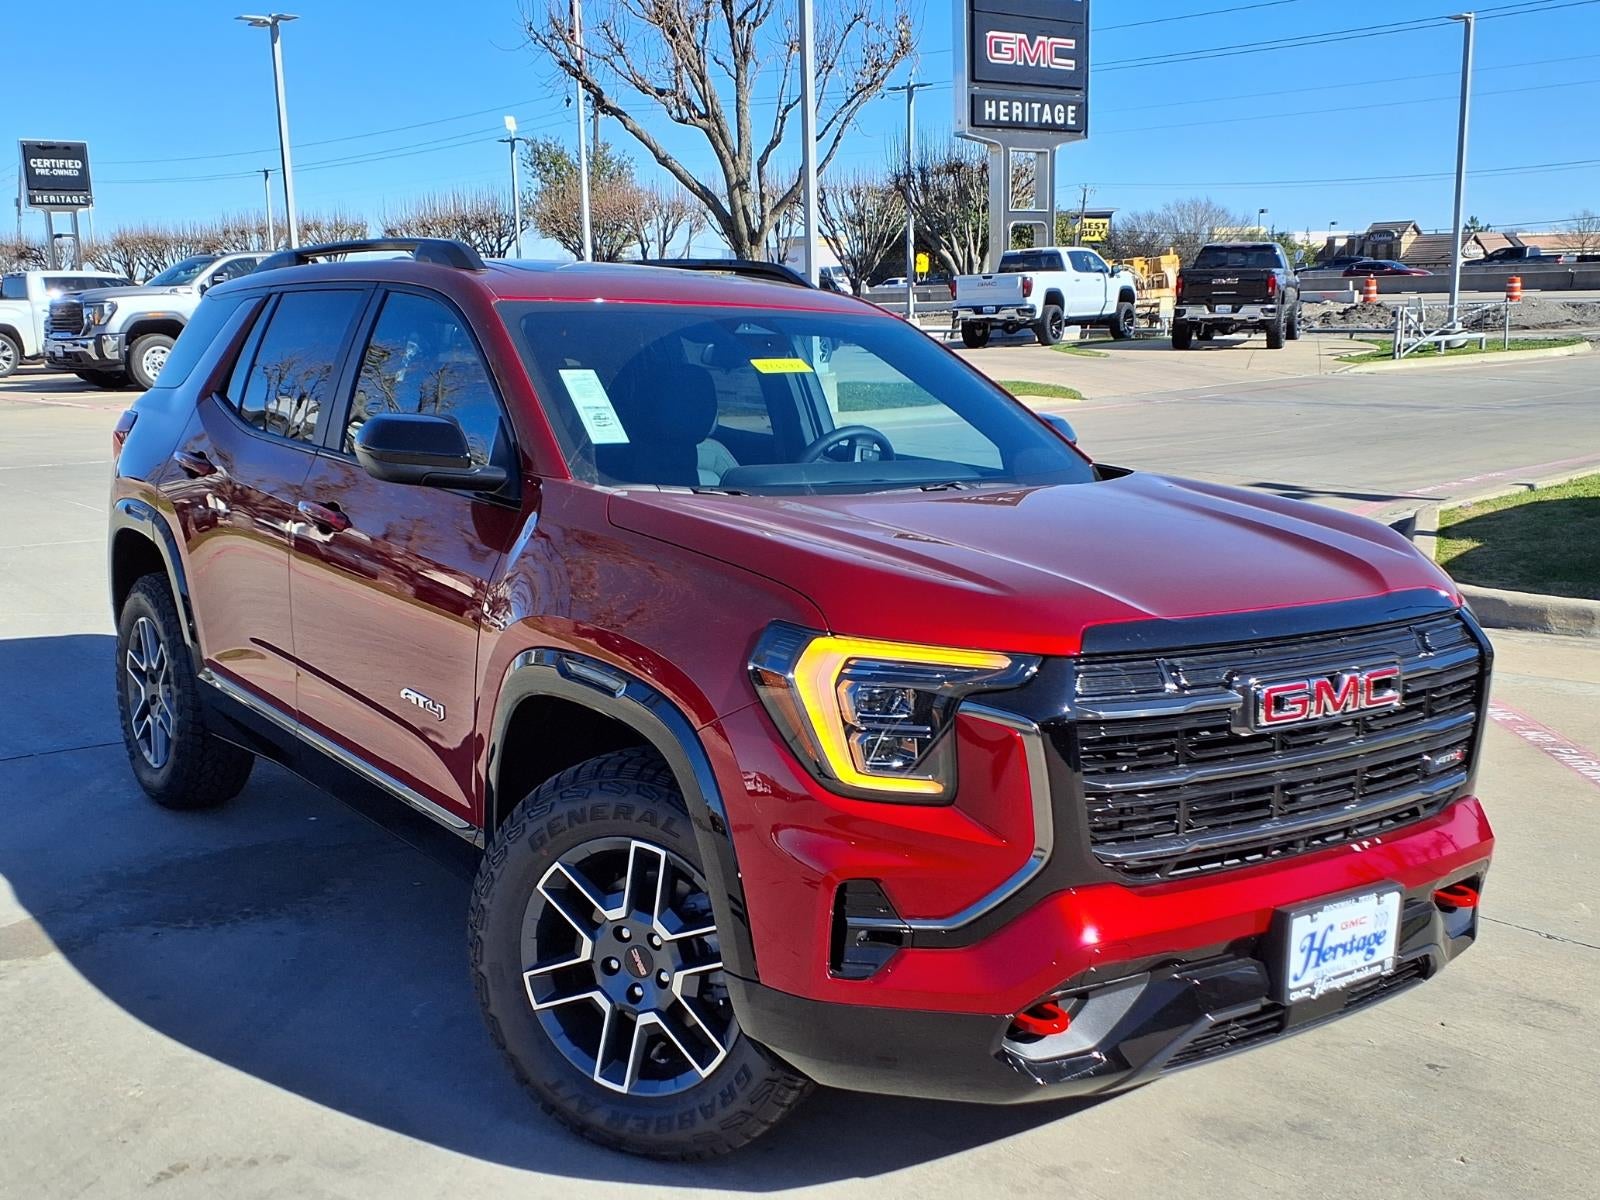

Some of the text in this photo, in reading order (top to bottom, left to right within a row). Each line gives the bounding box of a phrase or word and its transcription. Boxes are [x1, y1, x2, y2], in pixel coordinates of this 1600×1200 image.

[985, 30, 1076, 71] GMC
[984, 100, 1076, 125] HERITAGE
[30, 158, 82, 169] CERTIFIED
[35, 168, 79, 176] PRE-OWNED
[35, 195, 86, 204] HERITAGE
[1081, 222, 1108, 230] BEST
[1081, 230, 1104, 238] BUY
[400, 688, 445, 720] AT4
[1262, 666, 1401, 725] GMC
[527, 803, 682, 853] GENERAL
[1341, 915, 1368, 931] GMC
[631, 948, 647, 976] GMC
[1292, 923, 1387, 981] Heritage
[604, 1062, 754, 1136] GRABBER
